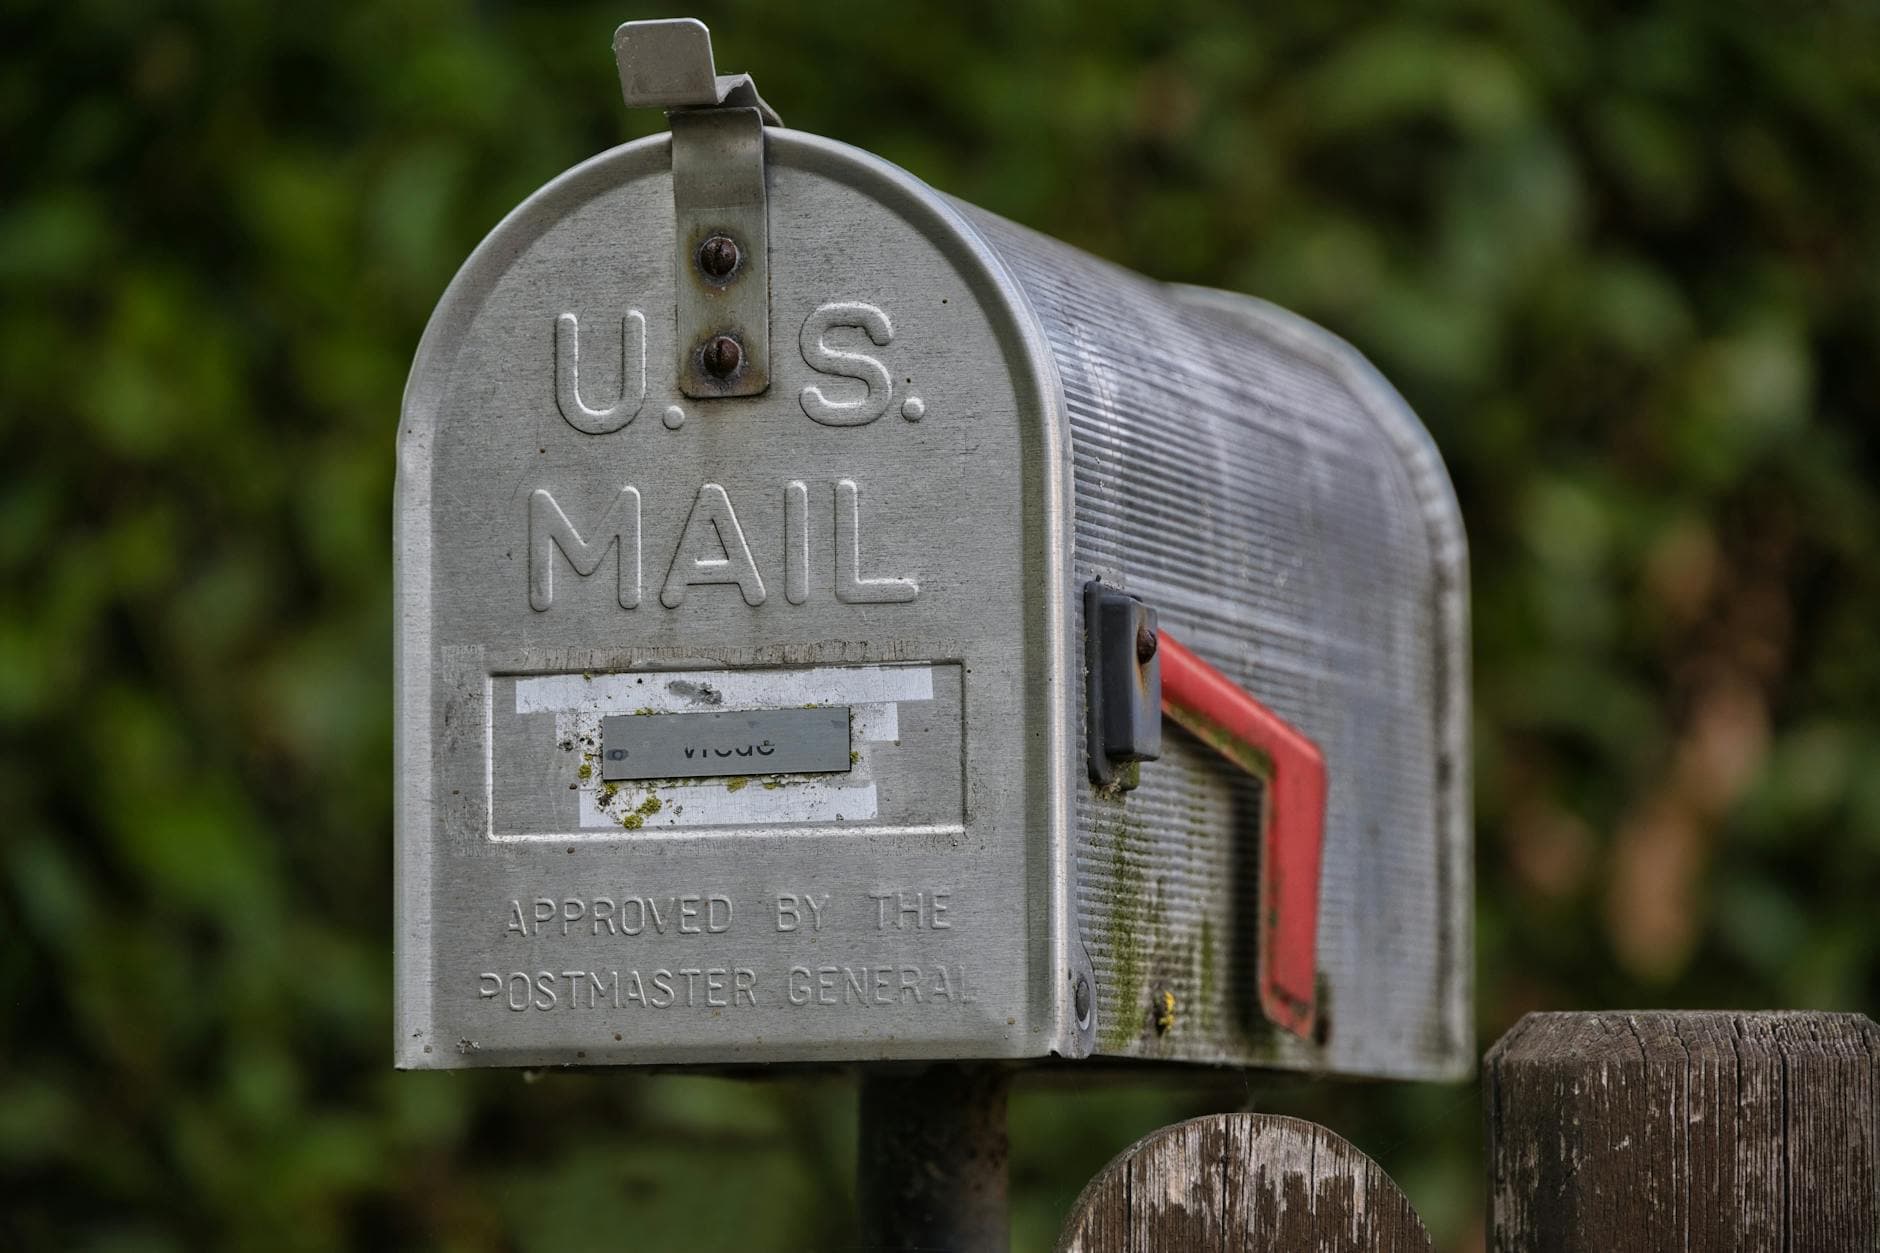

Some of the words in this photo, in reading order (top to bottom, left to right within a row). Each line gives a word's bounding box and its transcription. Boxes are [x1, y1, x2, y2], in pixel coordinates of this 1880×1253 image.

[528, 479, 920, 612] MAIL
[504, 894, 734, 937] APPROVED
[775, 893, 830, 933] BY
[867, 892, 952, 931] THE
[477, 966, 758, 1012] POSTMASTER
[787, 964, 976, 1007] GENERAL
